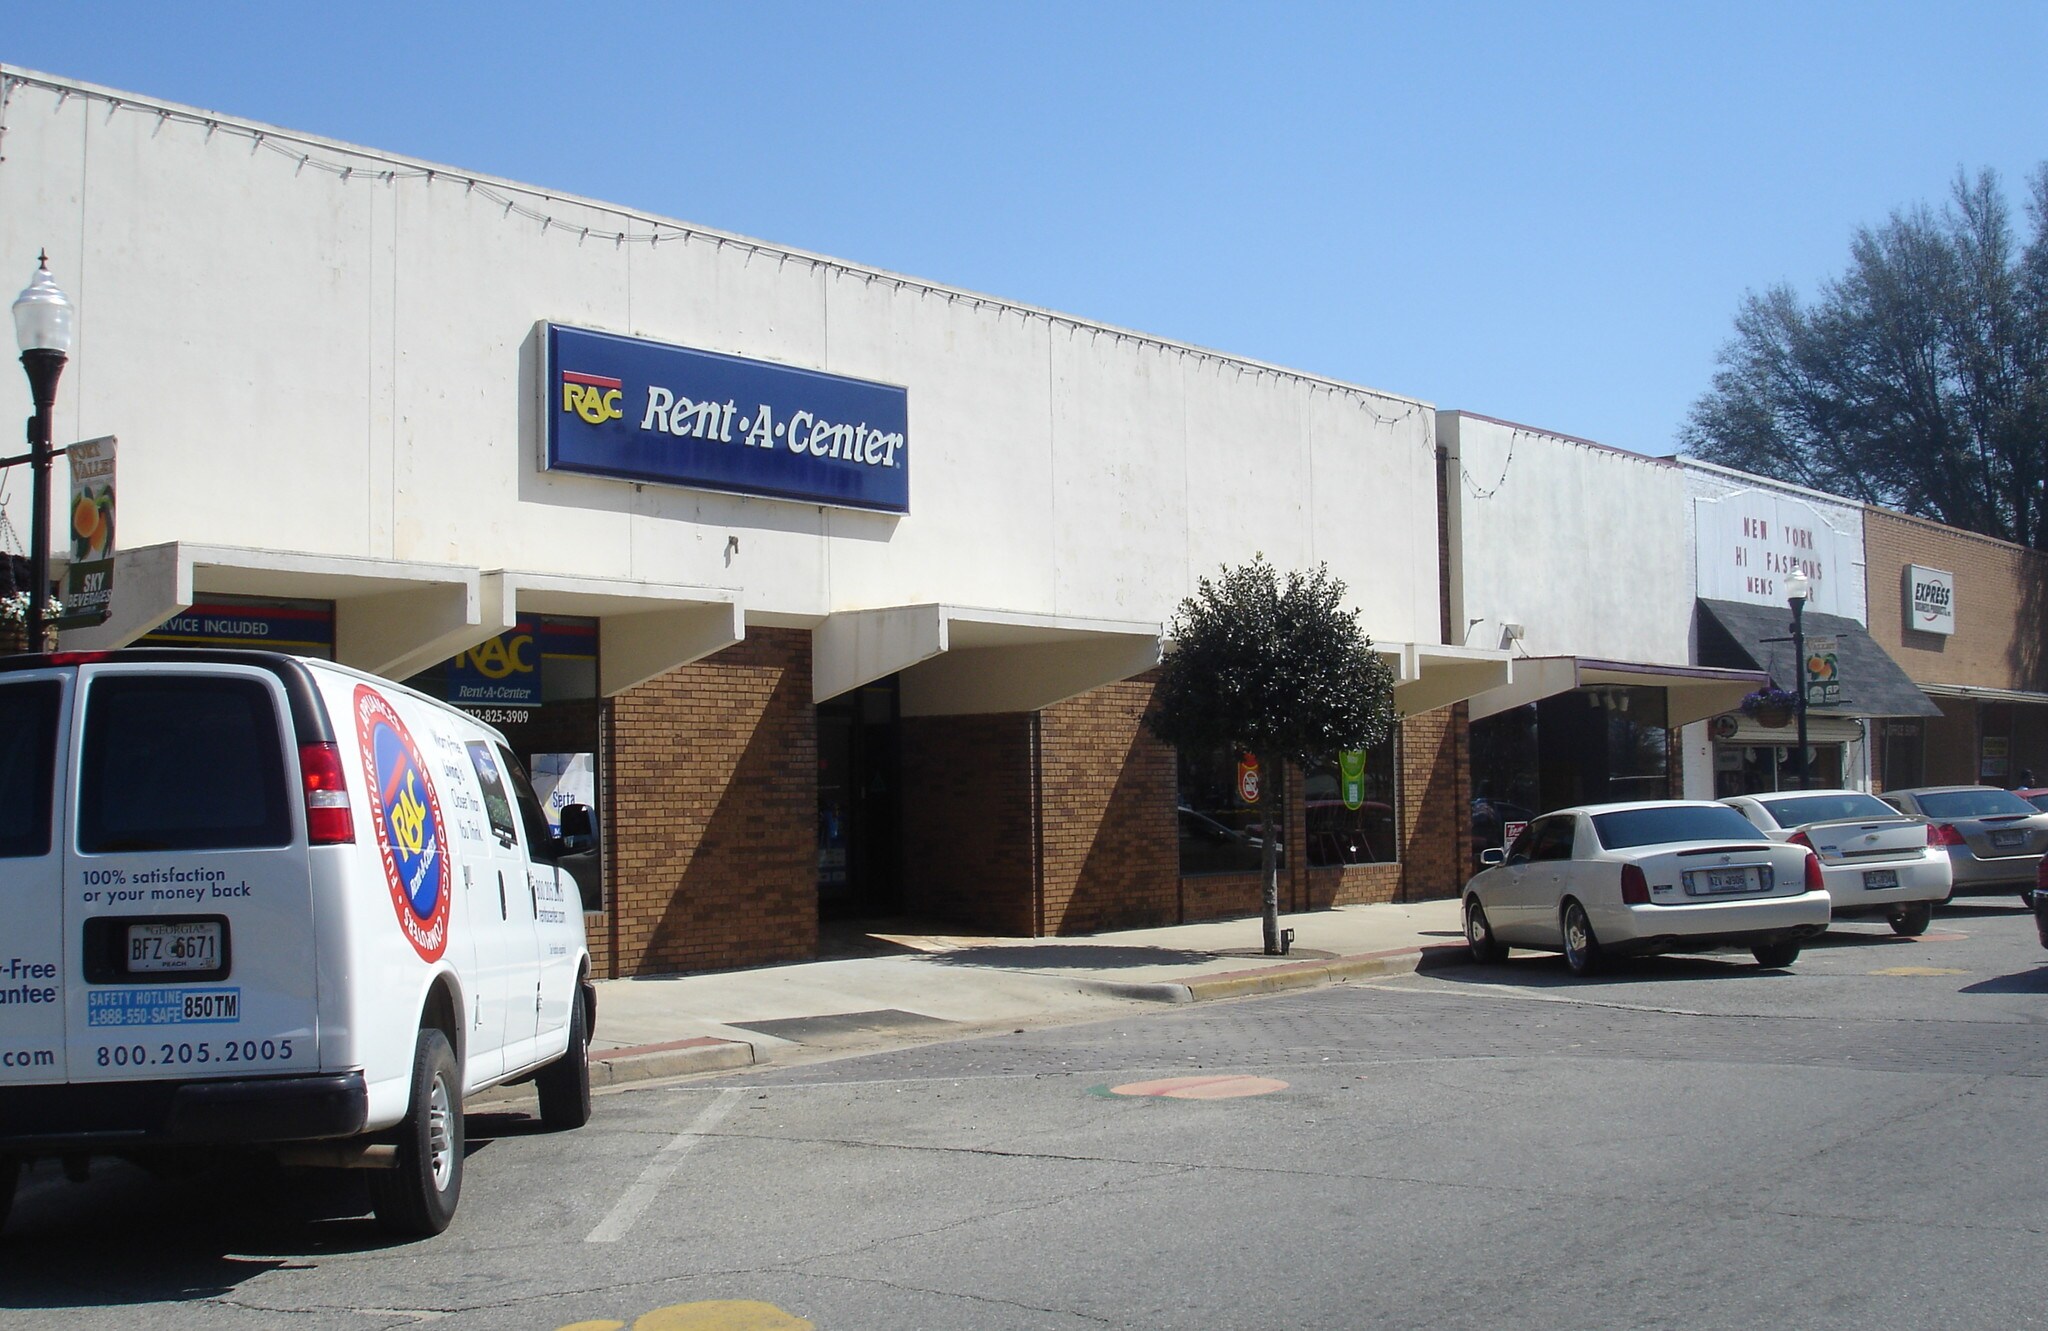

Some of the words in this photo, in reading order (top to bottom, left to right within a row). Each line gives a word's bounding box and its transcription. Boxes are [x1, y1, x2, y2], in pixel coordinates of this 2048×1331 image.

[563, 382, 623, 424] RAC
[1743, 516, 1767, 540] NEW
[1785, 526, 1813, 550] YORK
[1735, 545, 1747, 567] HI
[83, 572, 105, 592] SKY
[1747, 576, 1773, 595] MENS
[1915, 582, 1951, 606] EXPRESS
[155, 618, 199, 632] RVICE
[204, 620, 269, 635] INCLUDED
[359, 694, 401, 732] APPLIANCES
[552, 791, 576, 808] Serta
[362, 744, 399, 890] FURNITURE
[391, 768, 426, 862] RAC
[413, 746, 450, 902] ELECTRONICS
[83, 870, 127, 885] 100%
[132, 867, 225, 883] satisfaction
[83, 891, 101, 902] or
[107, 889, 144, 905] your
[151, 887, 205, 902] money
[211, 881, 251, 897] back
[149, 924, 200, 935] GEORGIA
[404, 907, 443, 950] COMPUTERS
[132, 938, 162, 960] BFZ
[176, 936, 215, 958] 6671
[0, 958, 56, 979] -Free
[90, 992, 132, 1006] SAFETY
[136, 990, 182, 1004] HOTLINE
[90, 1006, 181, 1025] 1-888-550-SAFE
[97, 1039, 293, 1067] 800.205.2005
